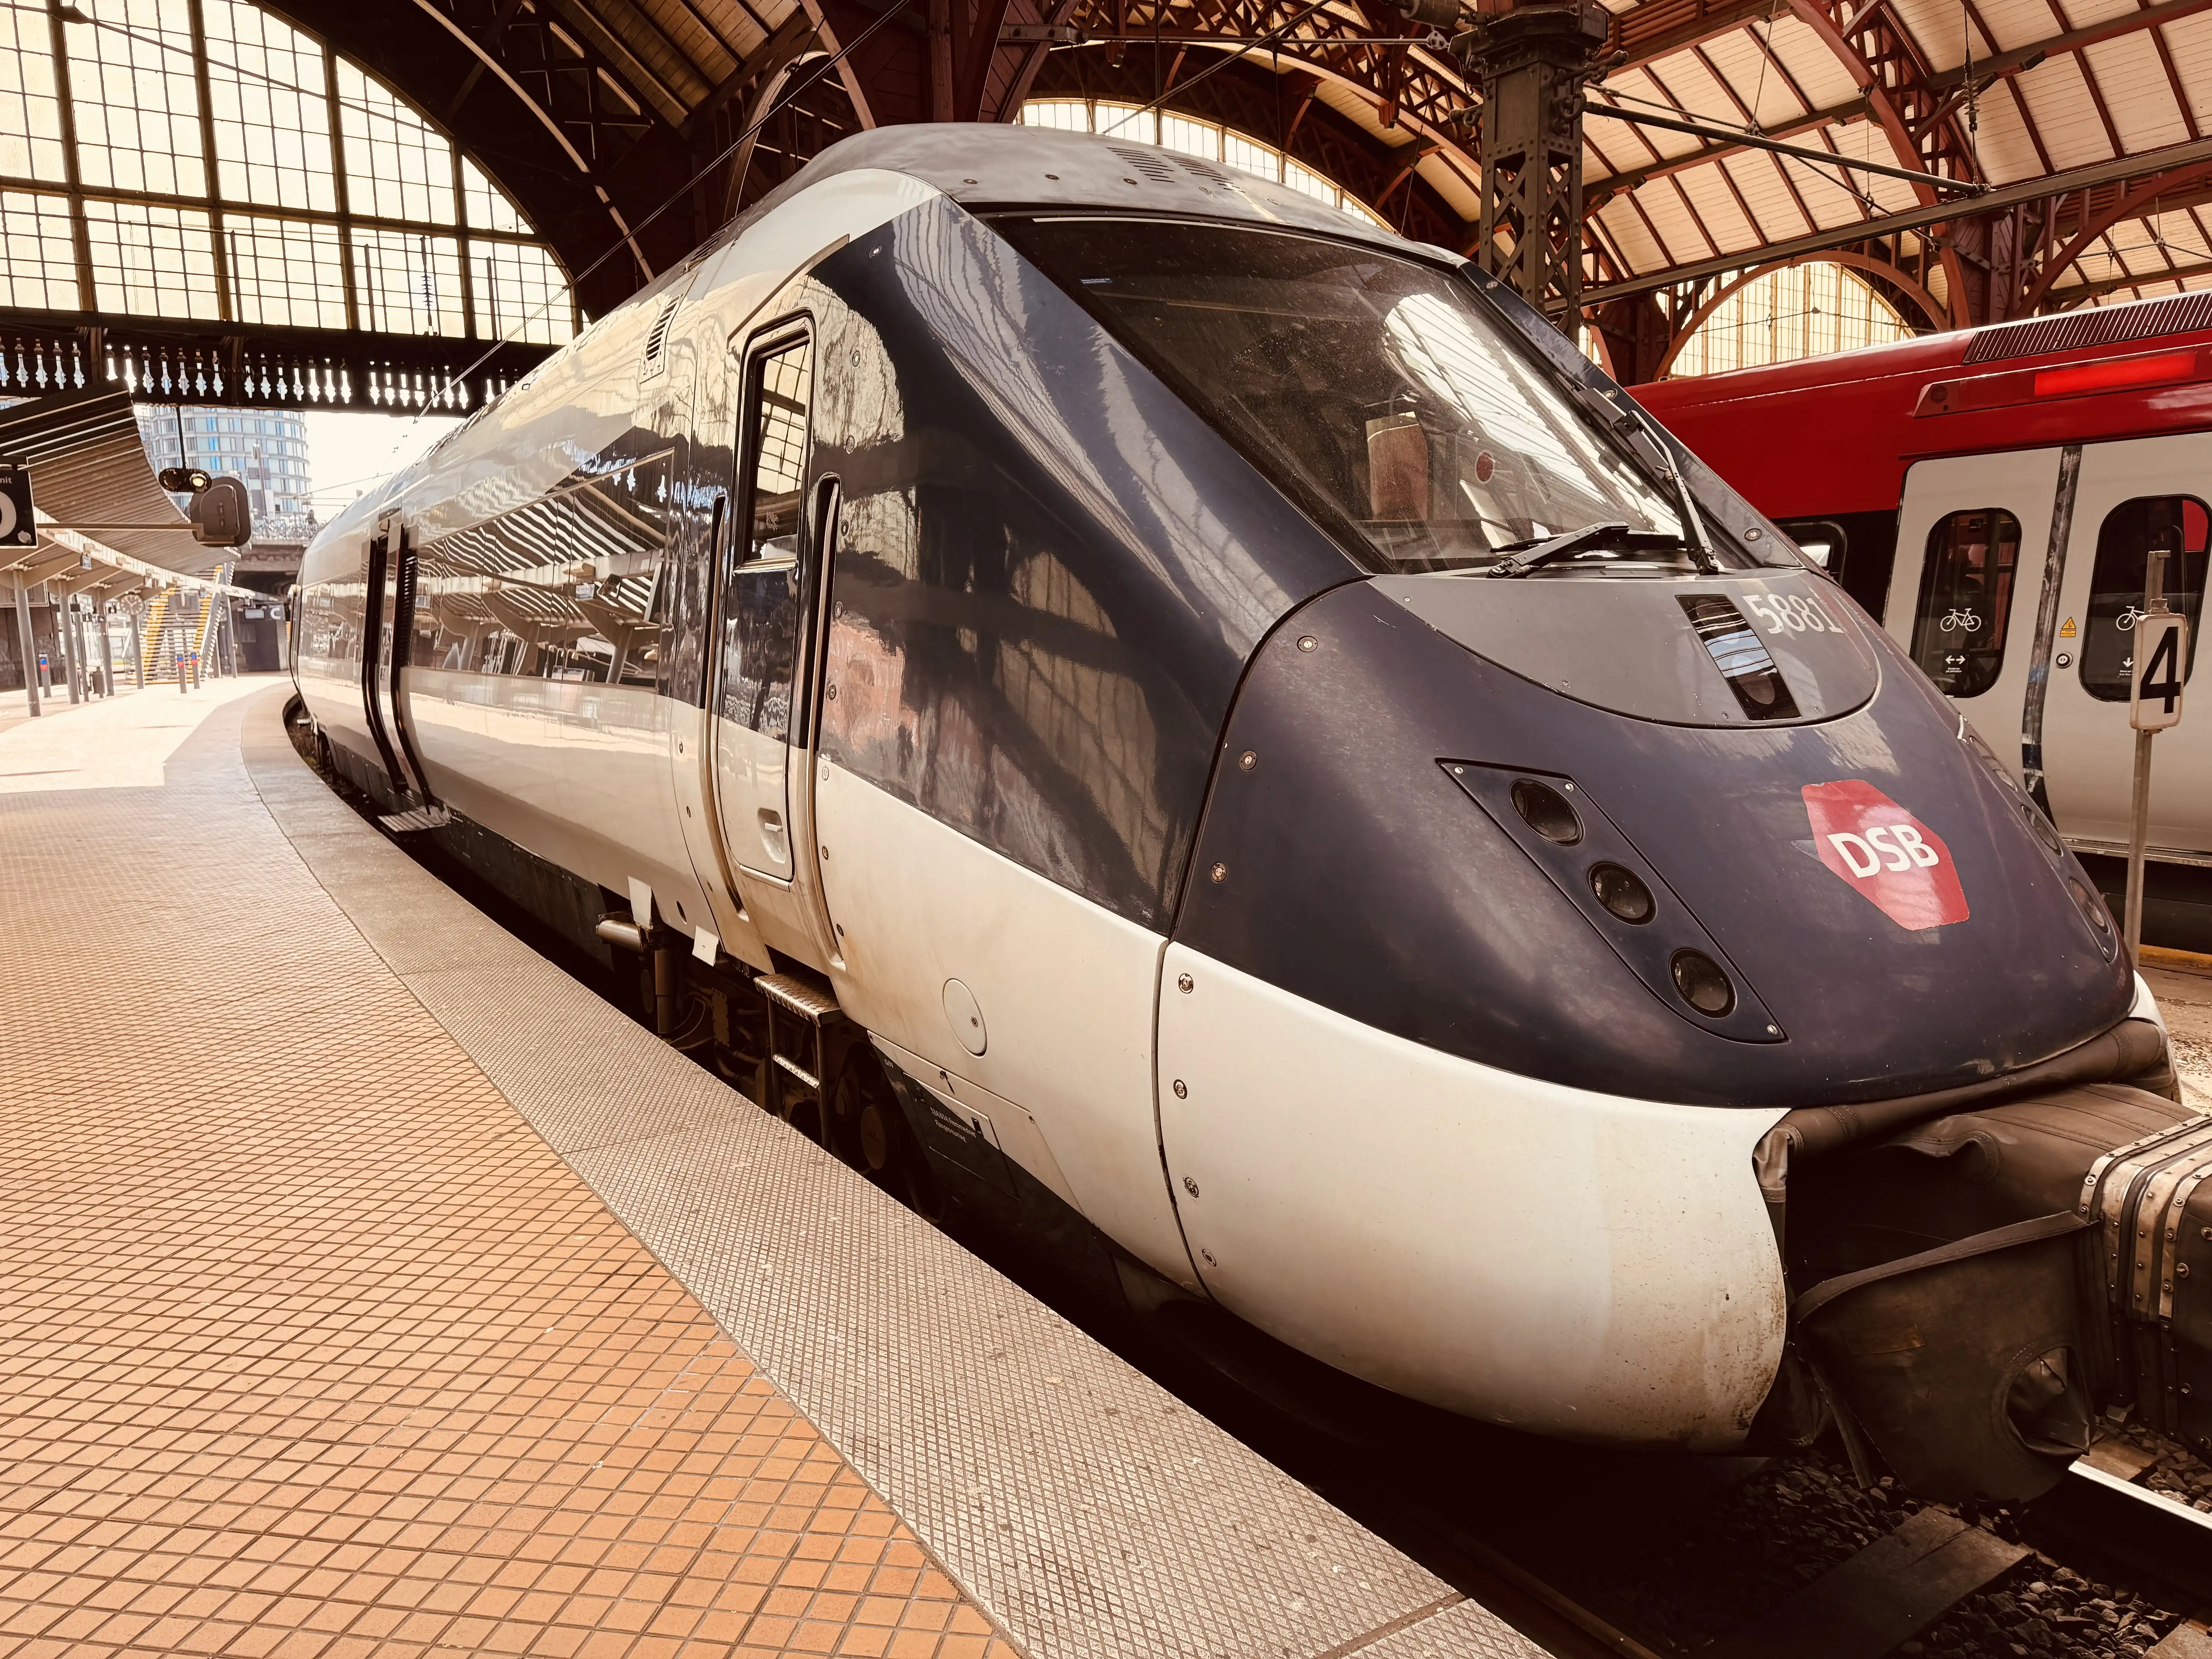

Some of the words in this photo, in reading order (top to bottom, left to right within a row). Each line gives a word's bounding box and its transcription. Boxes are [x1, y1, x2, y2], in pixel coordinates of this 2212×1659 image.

[1742, 593, 1844, 634] 5881
[2139, 626, 2181, 714] 4
[1827, 824, 1939, 878] DSB
